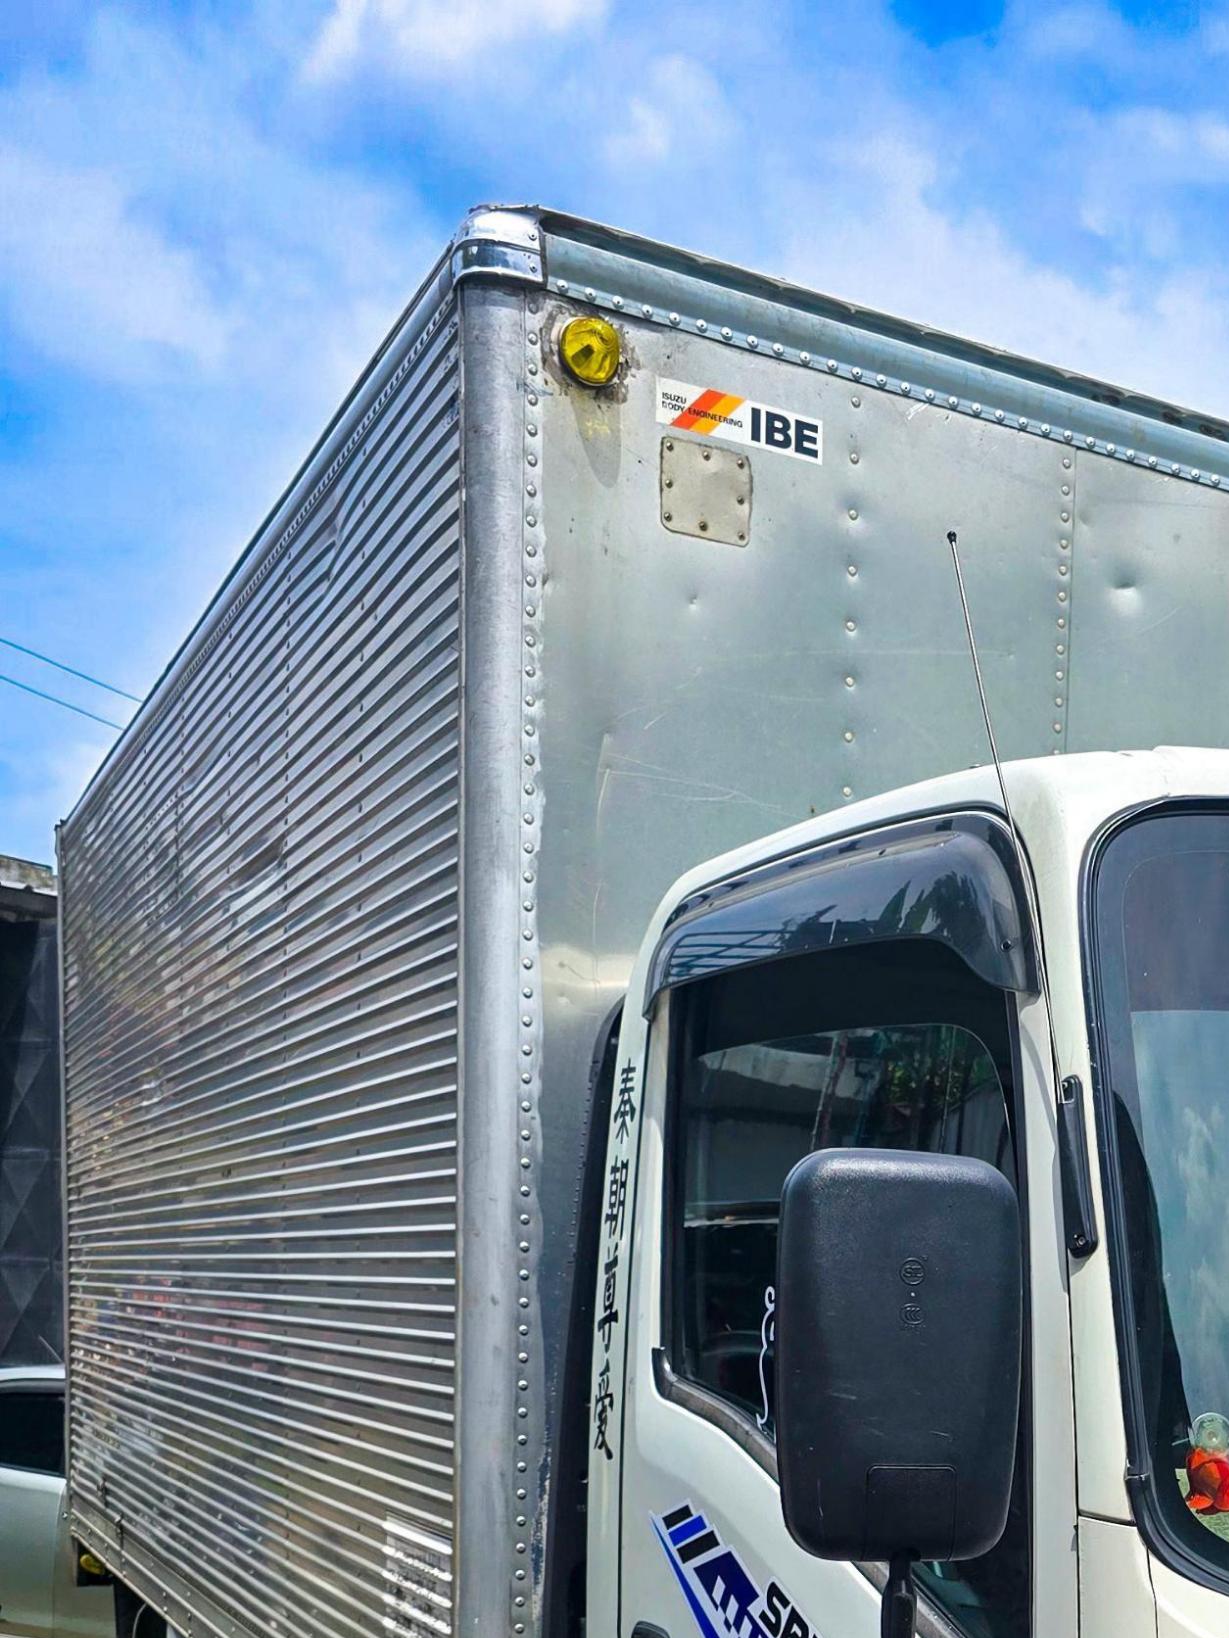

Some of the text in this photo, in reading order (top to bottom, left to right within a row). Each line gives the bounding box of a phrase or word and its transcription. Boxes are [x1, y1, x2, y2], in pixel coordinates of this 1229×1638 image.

[661, 391, 687, 405] ISUZU
[688, 406, 744, 429] ENGINEERING
[751, 407, 818, 459] IBE
